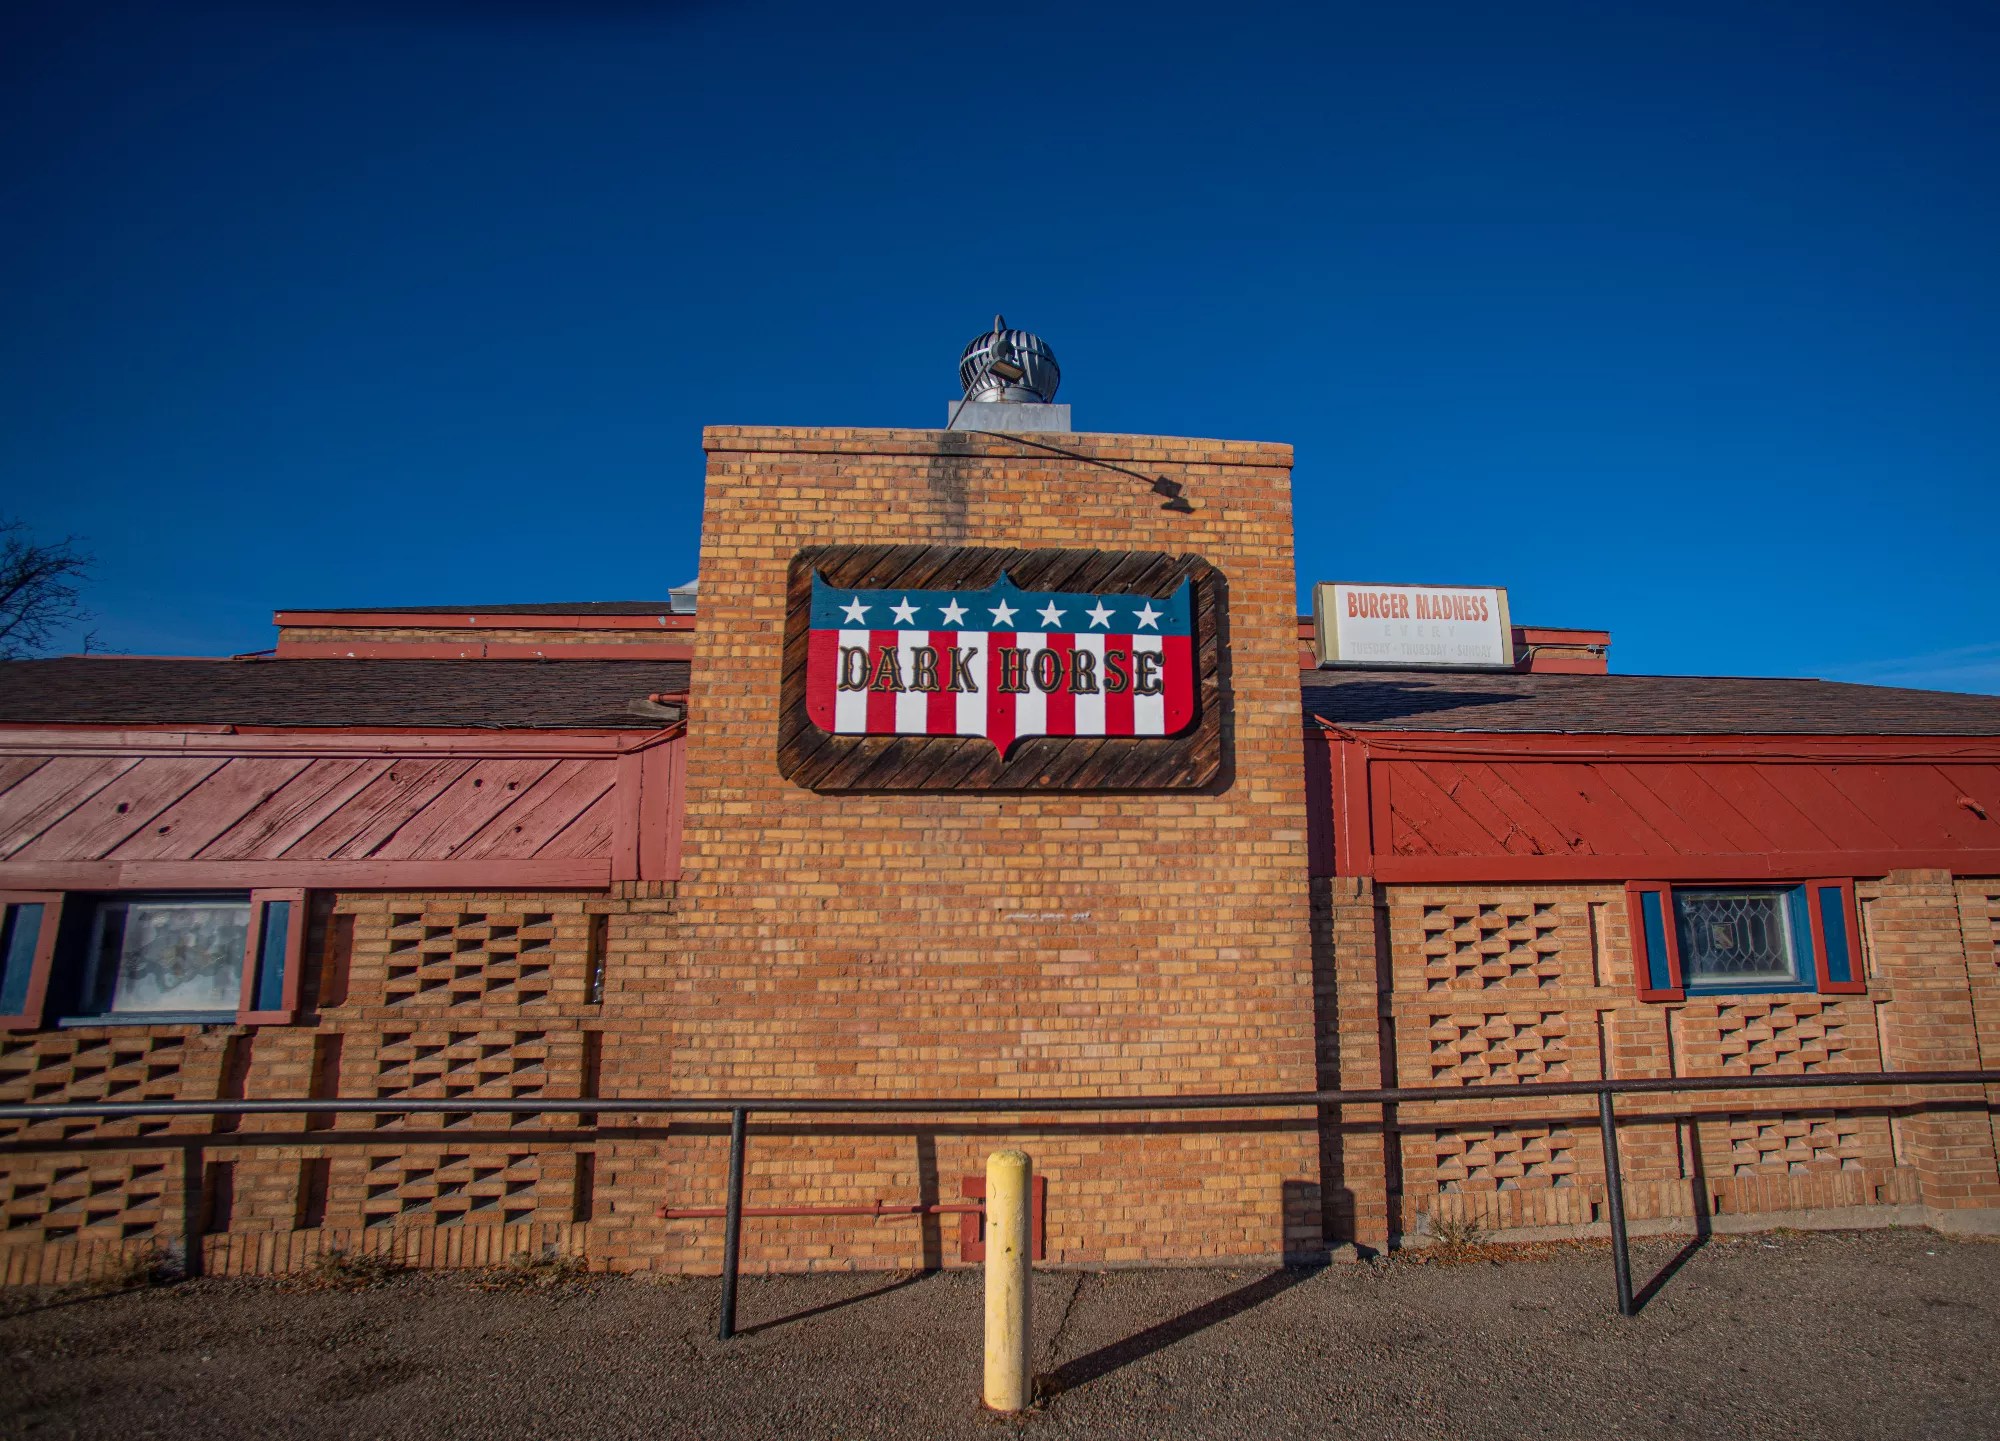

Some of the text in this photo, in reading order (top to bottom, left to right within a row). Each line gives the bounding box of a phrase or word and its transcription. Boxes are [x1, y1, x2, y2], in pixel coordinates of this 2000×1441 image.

[1347, 592, 1489, 622] BURGER MADNESS
[1383, 624, 1455, 638] EVERY
[837, 645, 1166, 695] DARK HORSE
